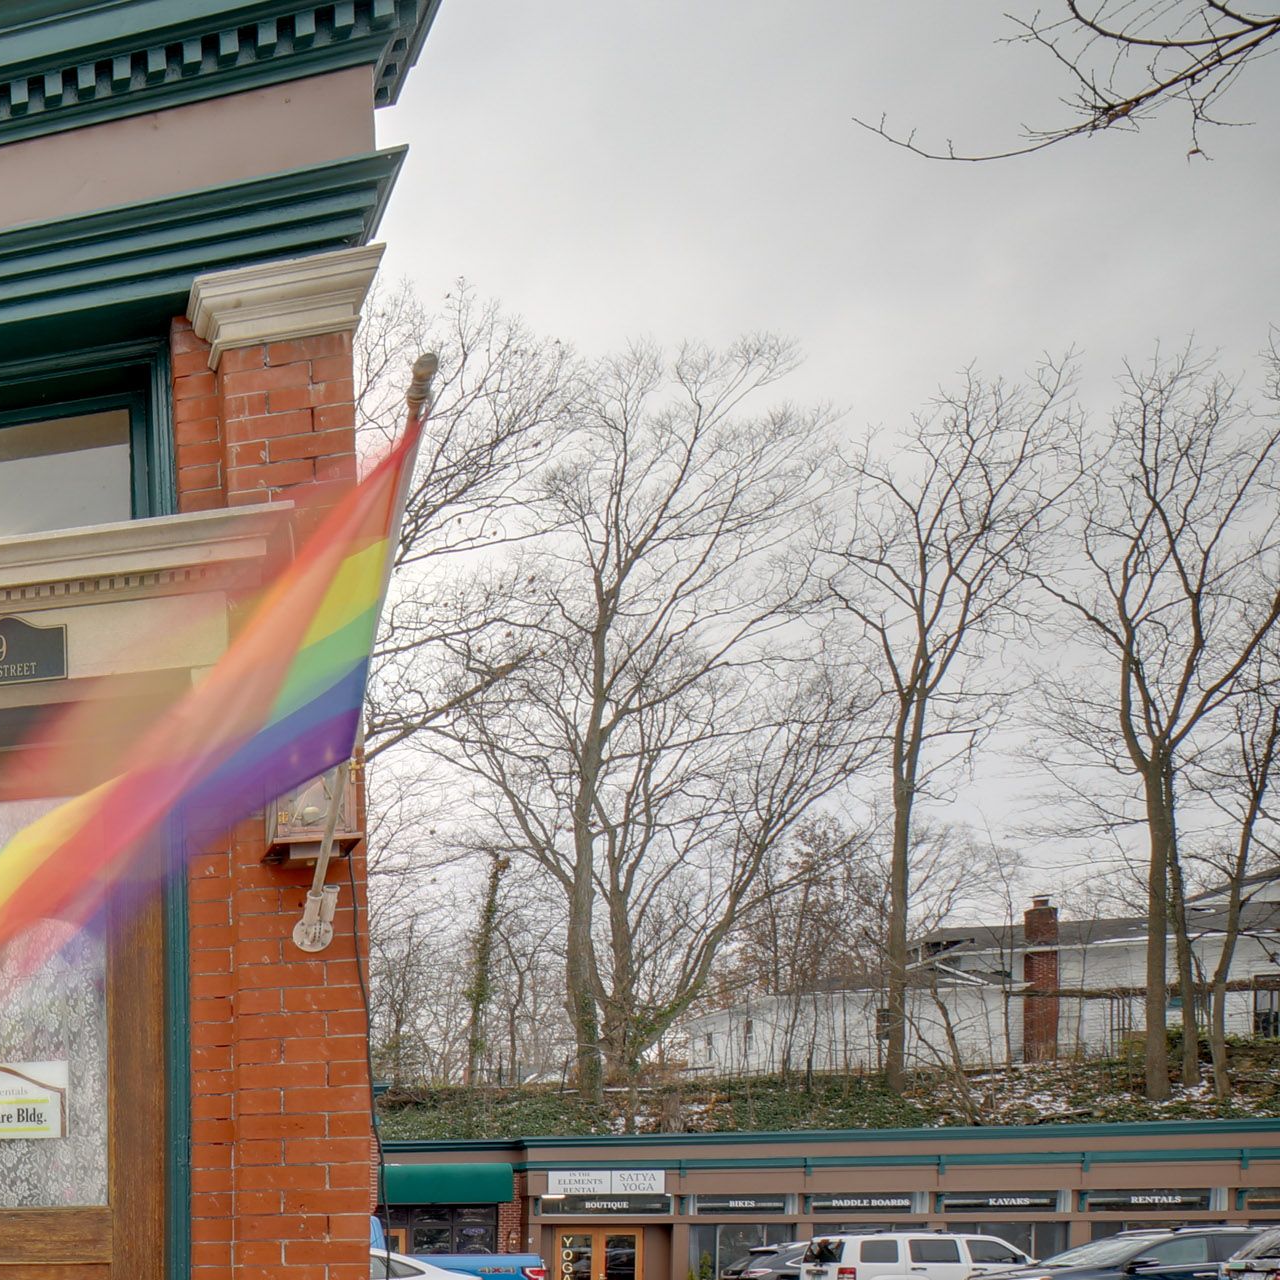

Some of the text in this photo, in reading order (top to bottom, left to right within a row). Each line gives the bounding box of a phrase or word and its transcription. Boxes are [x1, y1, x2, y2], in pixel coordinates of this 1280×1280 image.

[17, 1107, 47, 1124] Bldg.
[619, 1173, 656, 1182] SATYA
[622, 1183, 654, 1192] YOGA
[729, 1200, 755, 1208] BIKES
[832, 1198, 910, 1207] PADDLE BOARDS
[988, 1198, 1030, 1206] KAYAKS
[1130, 1195, 1182, 1204] RENTALS
[585, 1201, 629, 1210] BOUTIQUE
